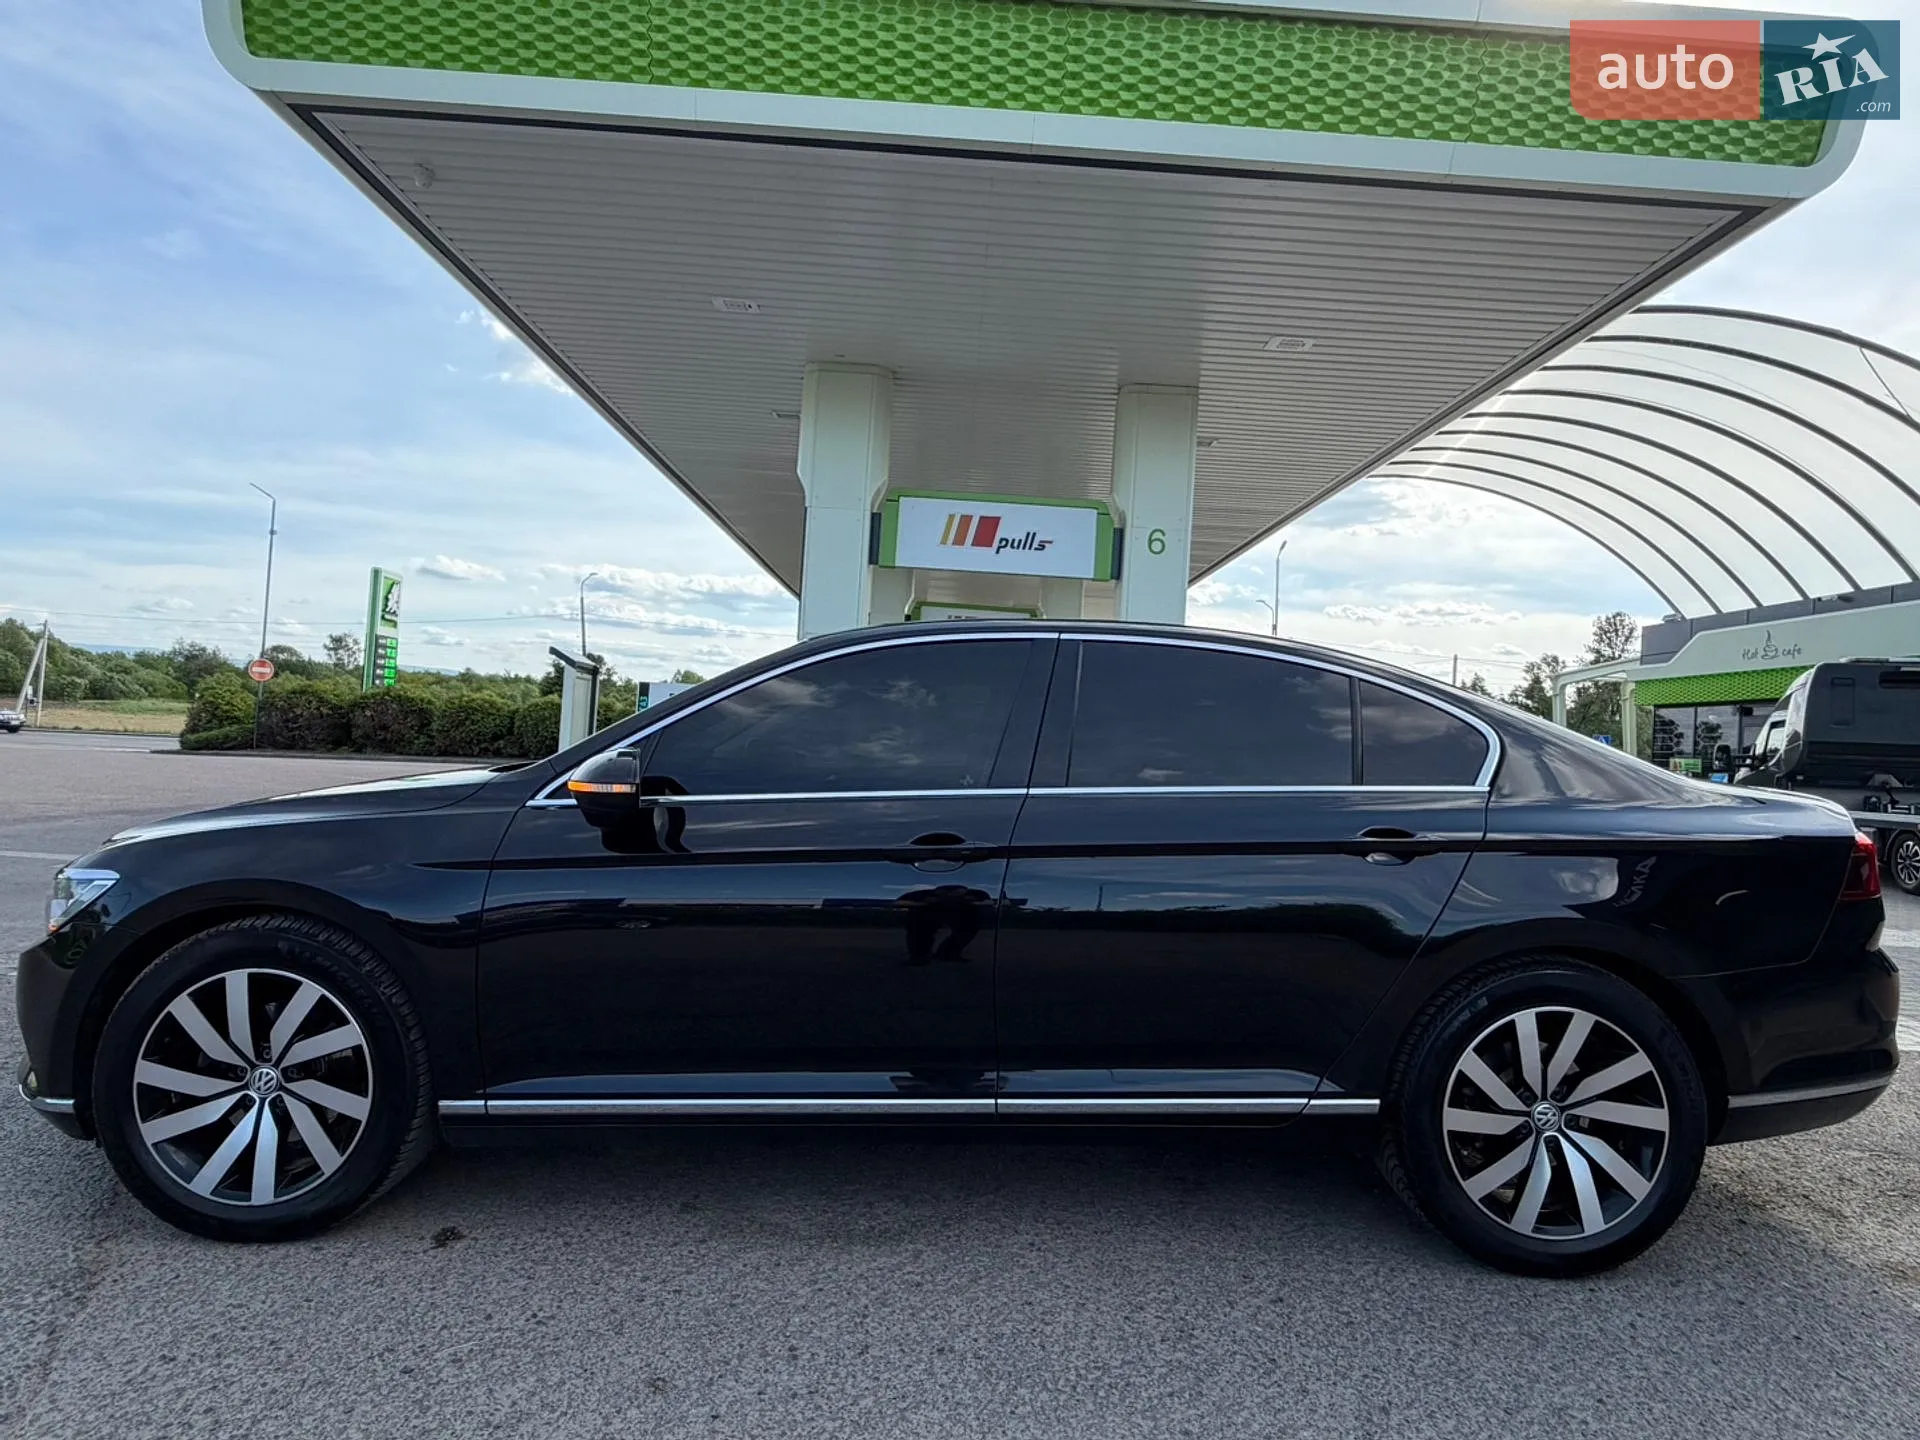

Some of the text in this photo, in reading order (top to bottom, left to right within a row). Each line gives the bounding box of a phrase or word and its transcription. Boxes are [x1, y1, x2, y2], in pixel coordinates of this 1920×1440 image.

[995, 532, 1054, 554] pulls
[1147, 528, 1166, 555] 6
[1742, 643, 1803, 660] Hot cafe
